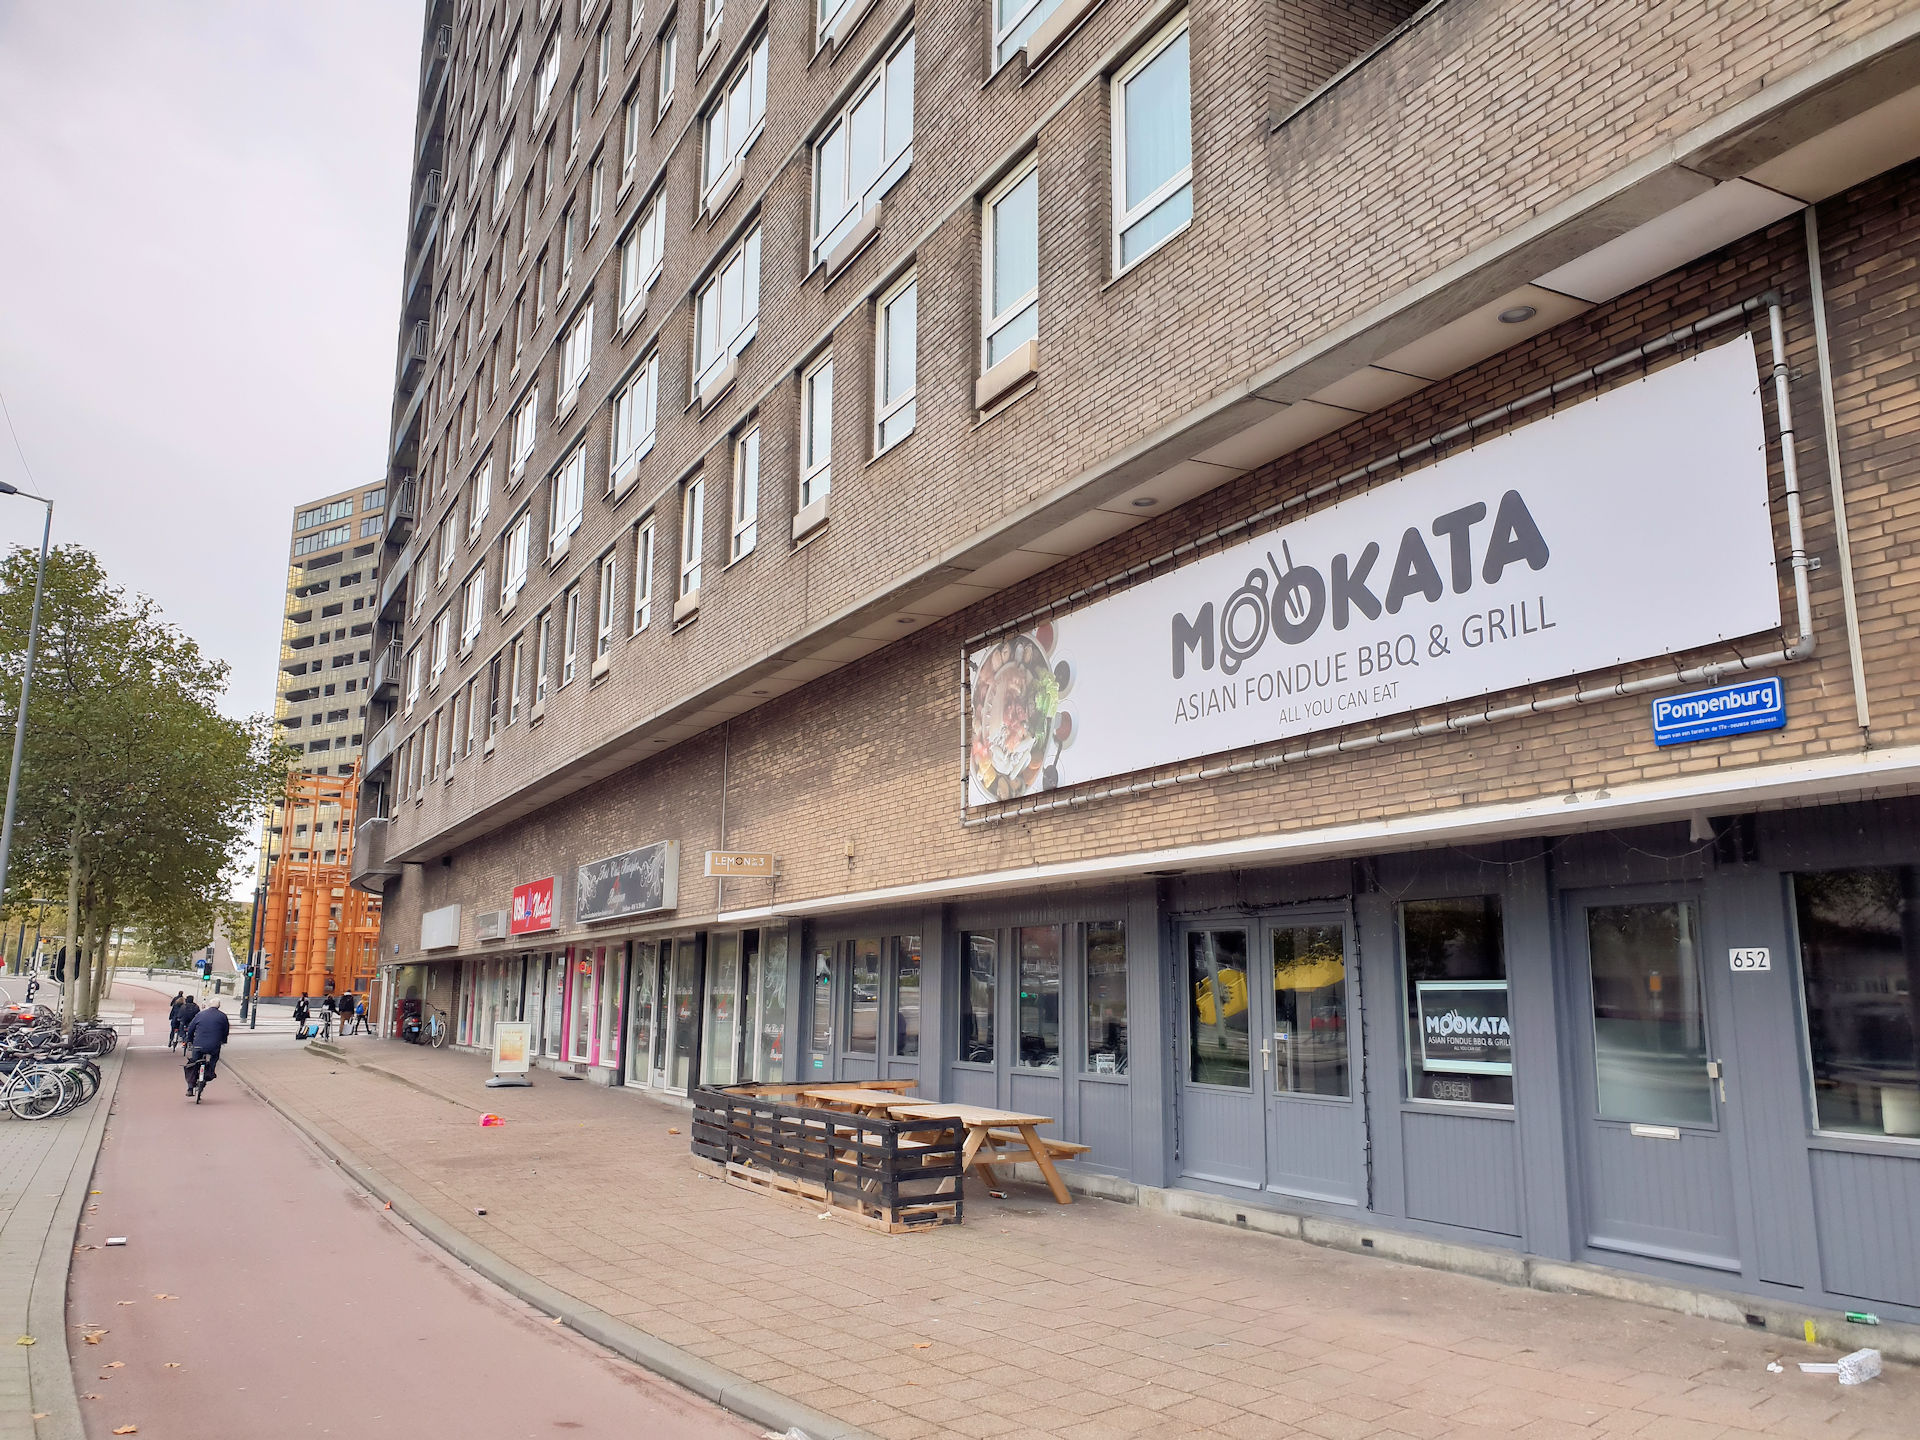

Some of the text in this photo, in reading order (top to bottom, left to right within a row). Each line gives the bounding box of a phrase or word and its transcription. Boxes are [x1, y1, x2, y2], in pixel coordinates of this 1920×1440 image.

[1171, 489, 1549, 679] MOOKATA
[1174, 595, 1557, 725] ASIAN FONDUE BBQ & GRILL
[1278, 681, 1400, 725] ALL YOU CAN EAT
[1658, 686, 1773, 721] Pompenburg
[513, 896, 526, 921] USA
[1733, 951, 1767, 968] 652
[1426, 1009, 1510, 1036] MOOKATA
[1428, 1036, 1446, 1044] ASIAN
[1446, 1036, 1473, 1045] FONDUE
[1473, 1037, 1487, 1046] BBQ
[1487, 1038, 1494, 1046] &
